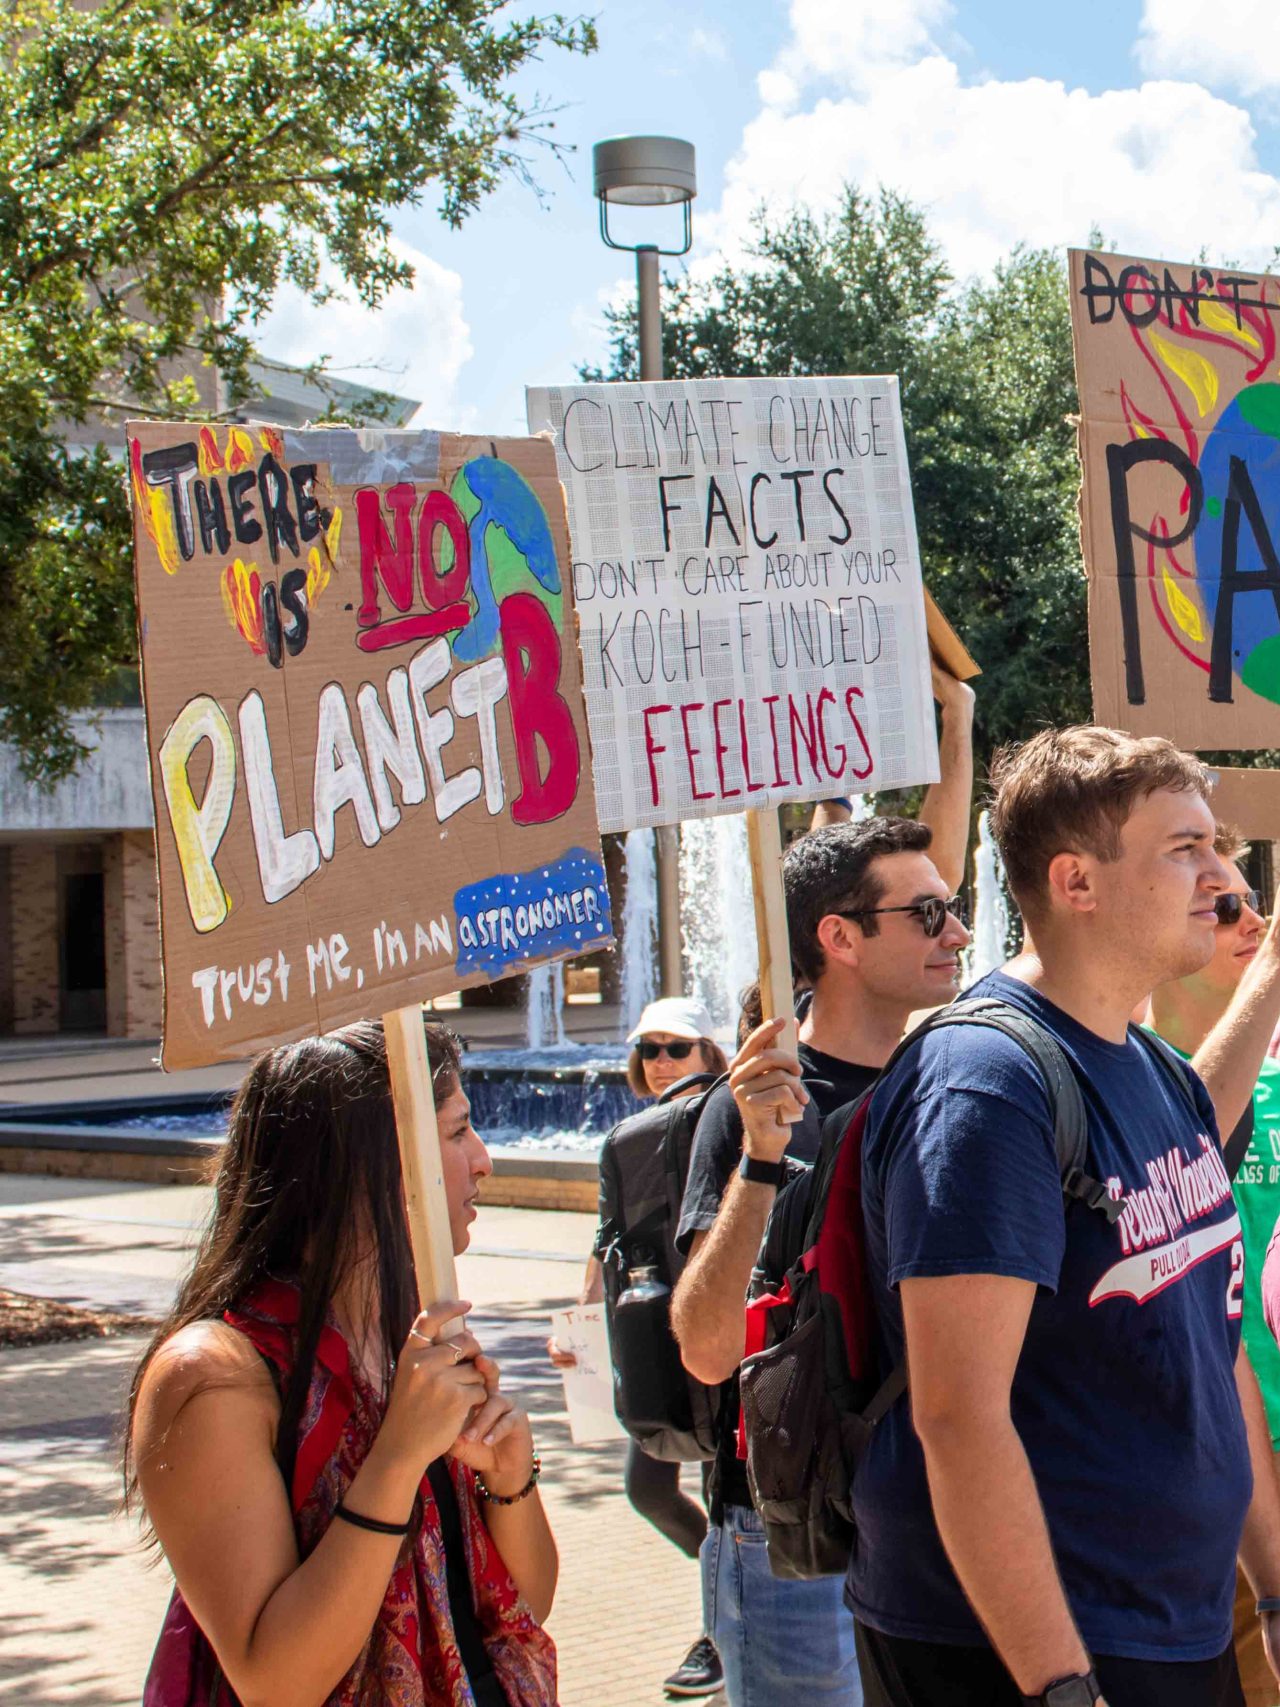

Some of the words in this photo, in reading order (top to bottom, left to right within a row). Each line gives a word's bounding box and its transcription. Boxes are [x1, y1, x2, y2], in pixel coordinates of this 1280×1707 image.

[563, 399, 749, 472] CLIMATE
[768, 396, 888, 464] CHANGE
[143, 441, 332, 565] THERE
[659, 468, 852, 553] FACTS
[353, 481, 473, 628] NO
[573, 559, 665, 601] DON'T
[683, 556, 750, 596] CARE
[764, 552, 832, 590] ABOUT
[841, 549, 901, 586] YOUR
[262, 566, 310, 668] IS
[158, 636, 508, 935] PLANET
[500, 592, 582, 827] B
[643, 687, 874, 807] FEELINGS
[414, 915, 453, 961] AN
[1233, 1164, 1264, 1184] LASS
